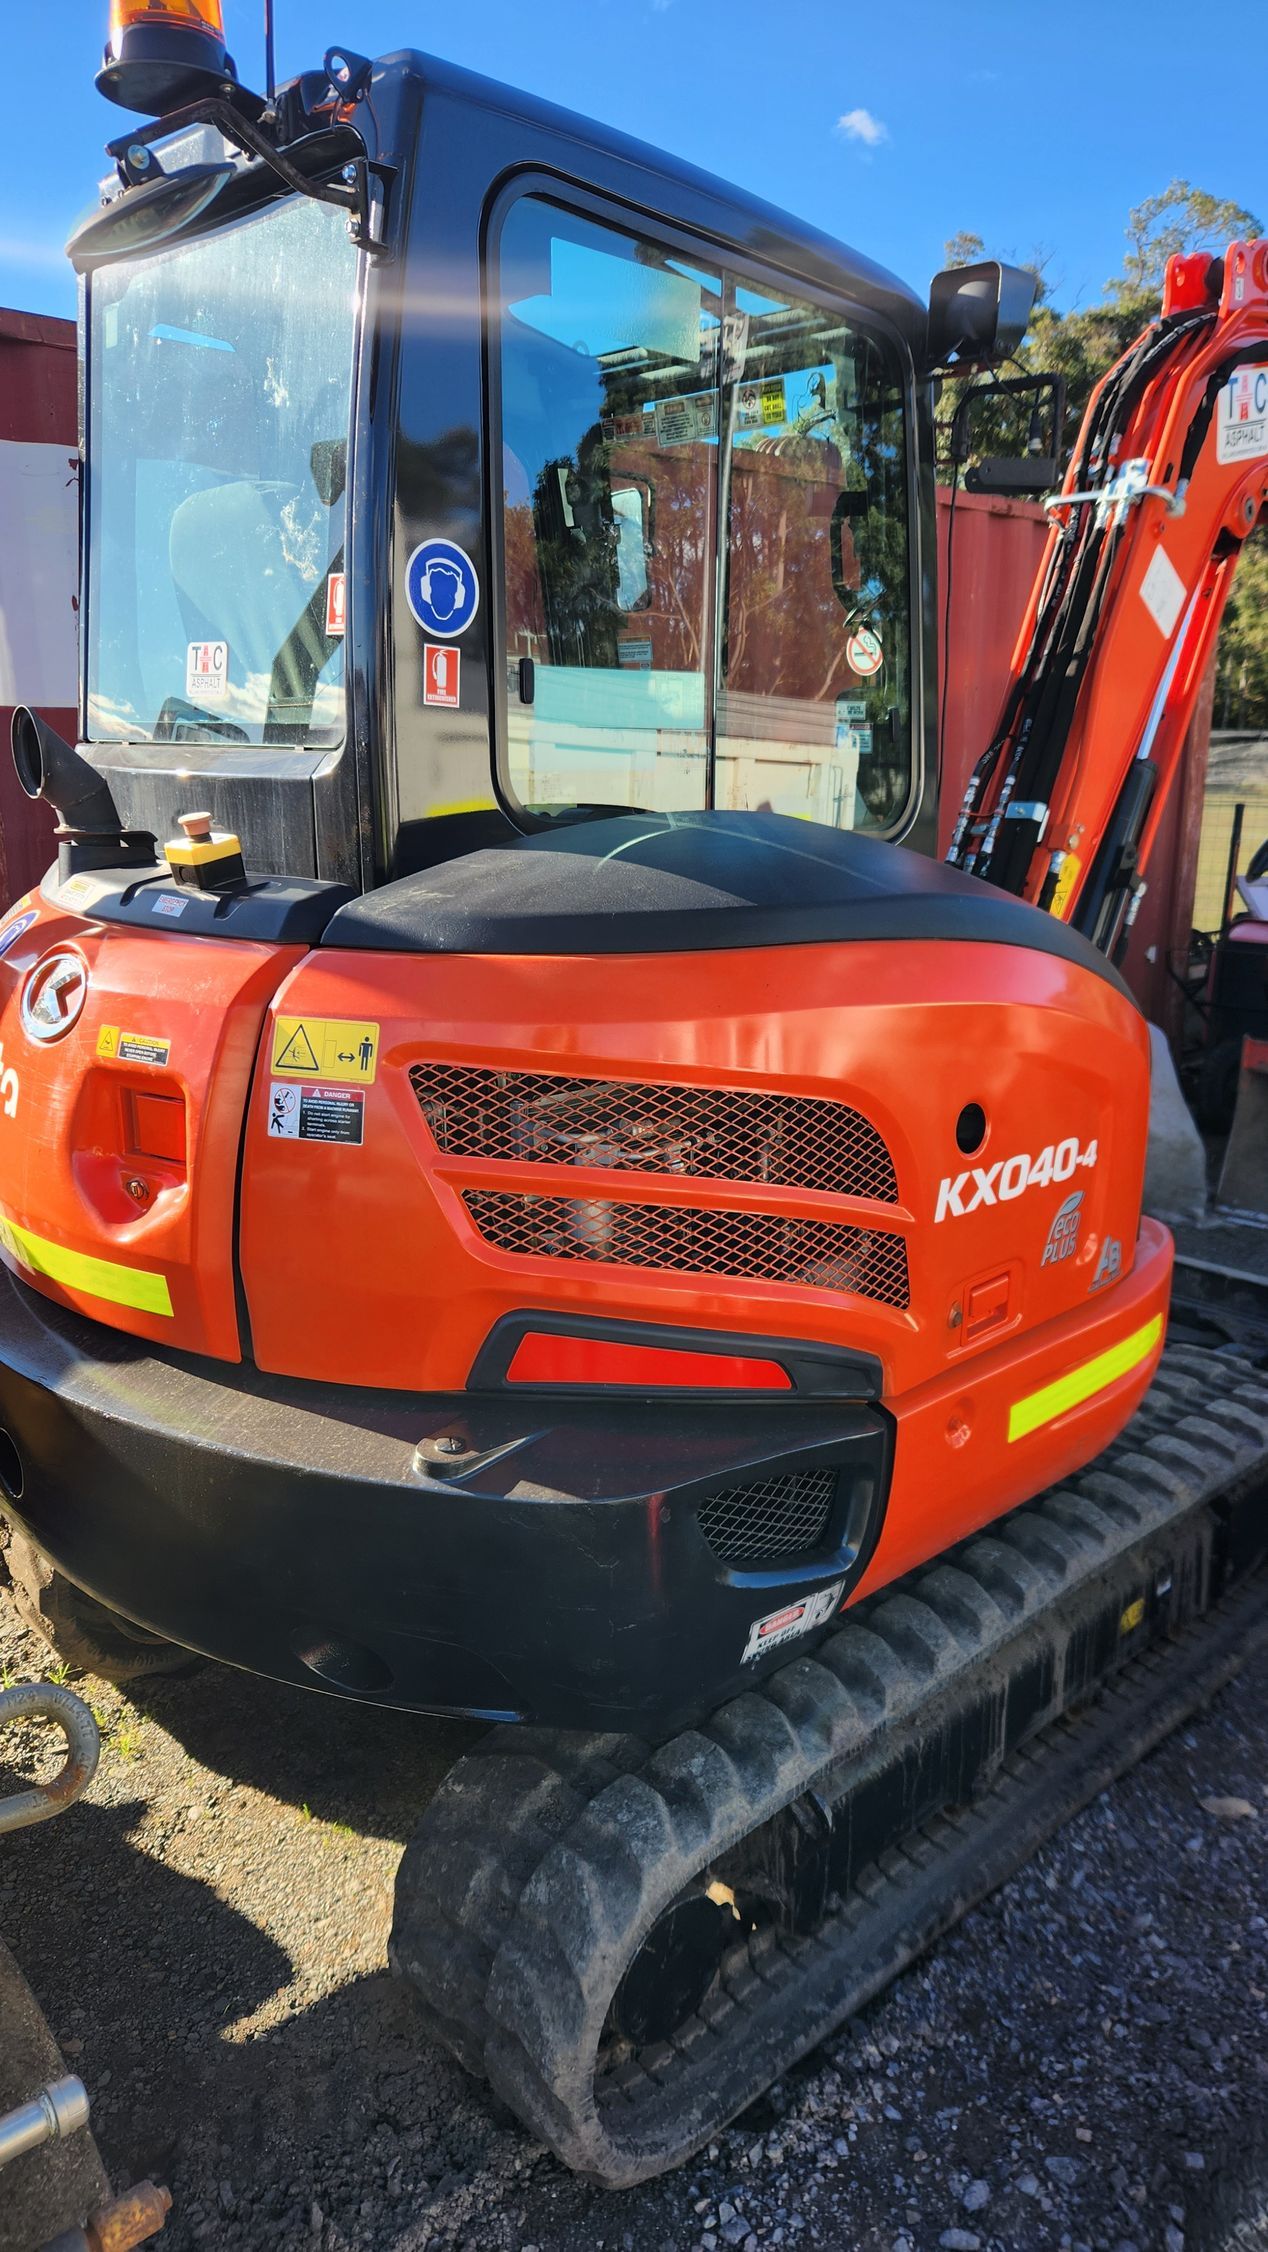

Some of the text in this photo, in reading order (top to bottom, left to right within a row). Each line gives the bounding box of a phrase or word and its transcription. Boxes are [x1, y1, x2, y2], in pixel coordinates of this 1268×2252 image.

[1225, 425, 1264, 447] ASPHALT
[191, 677, 221, 689] ASPHALT
[139, 1038, 159, 1046] CAUTION
[324, 1091, 350, 1099] DANGER
[934, 1136, 1098, 1224] KX040-4
[1054, 1210, 1082, 1241] eco
[1040, 1234, 1077, 1269] PLUS
[765, 1609, 799, 1629] DANGER
[759, 1634, 779, 1647] KEEP
